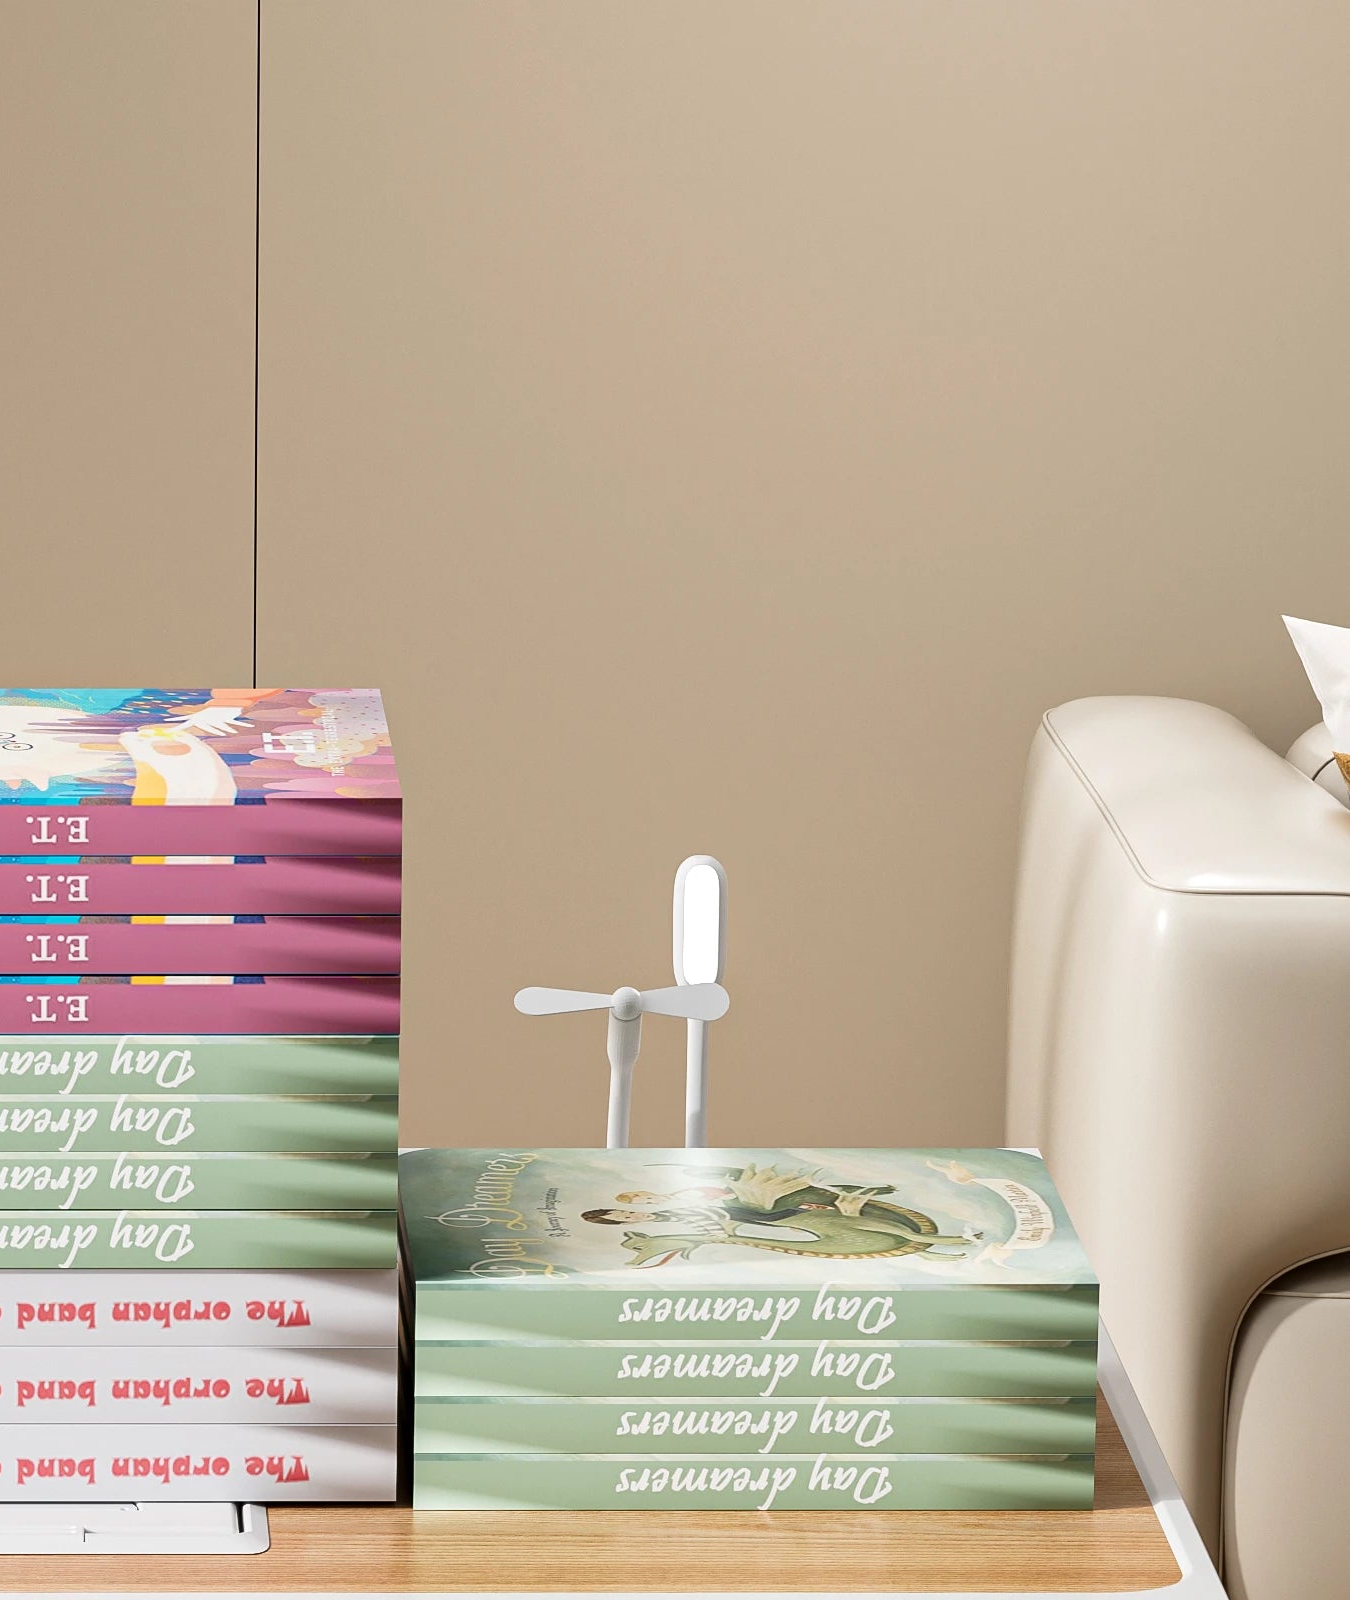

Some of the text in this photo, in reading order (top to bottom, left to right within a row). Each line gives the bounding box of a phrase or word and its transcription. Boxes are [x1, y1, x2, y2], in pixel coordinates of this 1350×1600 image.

[262, 732, 316, 754] E.T.
[330, 766, 345, 777] THE
[26, 816, 90, 844] E.T.
[26, 875, 90, 902] E.T.
[25, 935, 89, 962] E.T.
[25, 995, 89, 1022] E.T.
[110, 1035, 195, 1088] Day
[110, 1094, 195, 1145] Day
[110, 1152, 195, 1203] Day
[423, 1152, 570, 1280] Day Dreamers
[109, 1211, 195, 1261] Day
[18, 1302, 95, 1330] band
[112, 1300, 231, 1329] orphan
[246, 1300, 311, 1328] The
[618, 1281, 897, 1341] Day dreamers
[617, 1340, 895, 1397] Day dreamers
[18, 1380, 95, 1407] band
[112, 1378, 230, 1406] orphan
[246, 1378, 311, 1405] The
[616, 1397, 894, 1454] Day dreamers
[18, 1458, 94, 1485] band
[112, 1456, 230, 1484] orphan
[246, 1456, 310, 1483] The
[615, 1453, 892, 1510] Day dreamers
